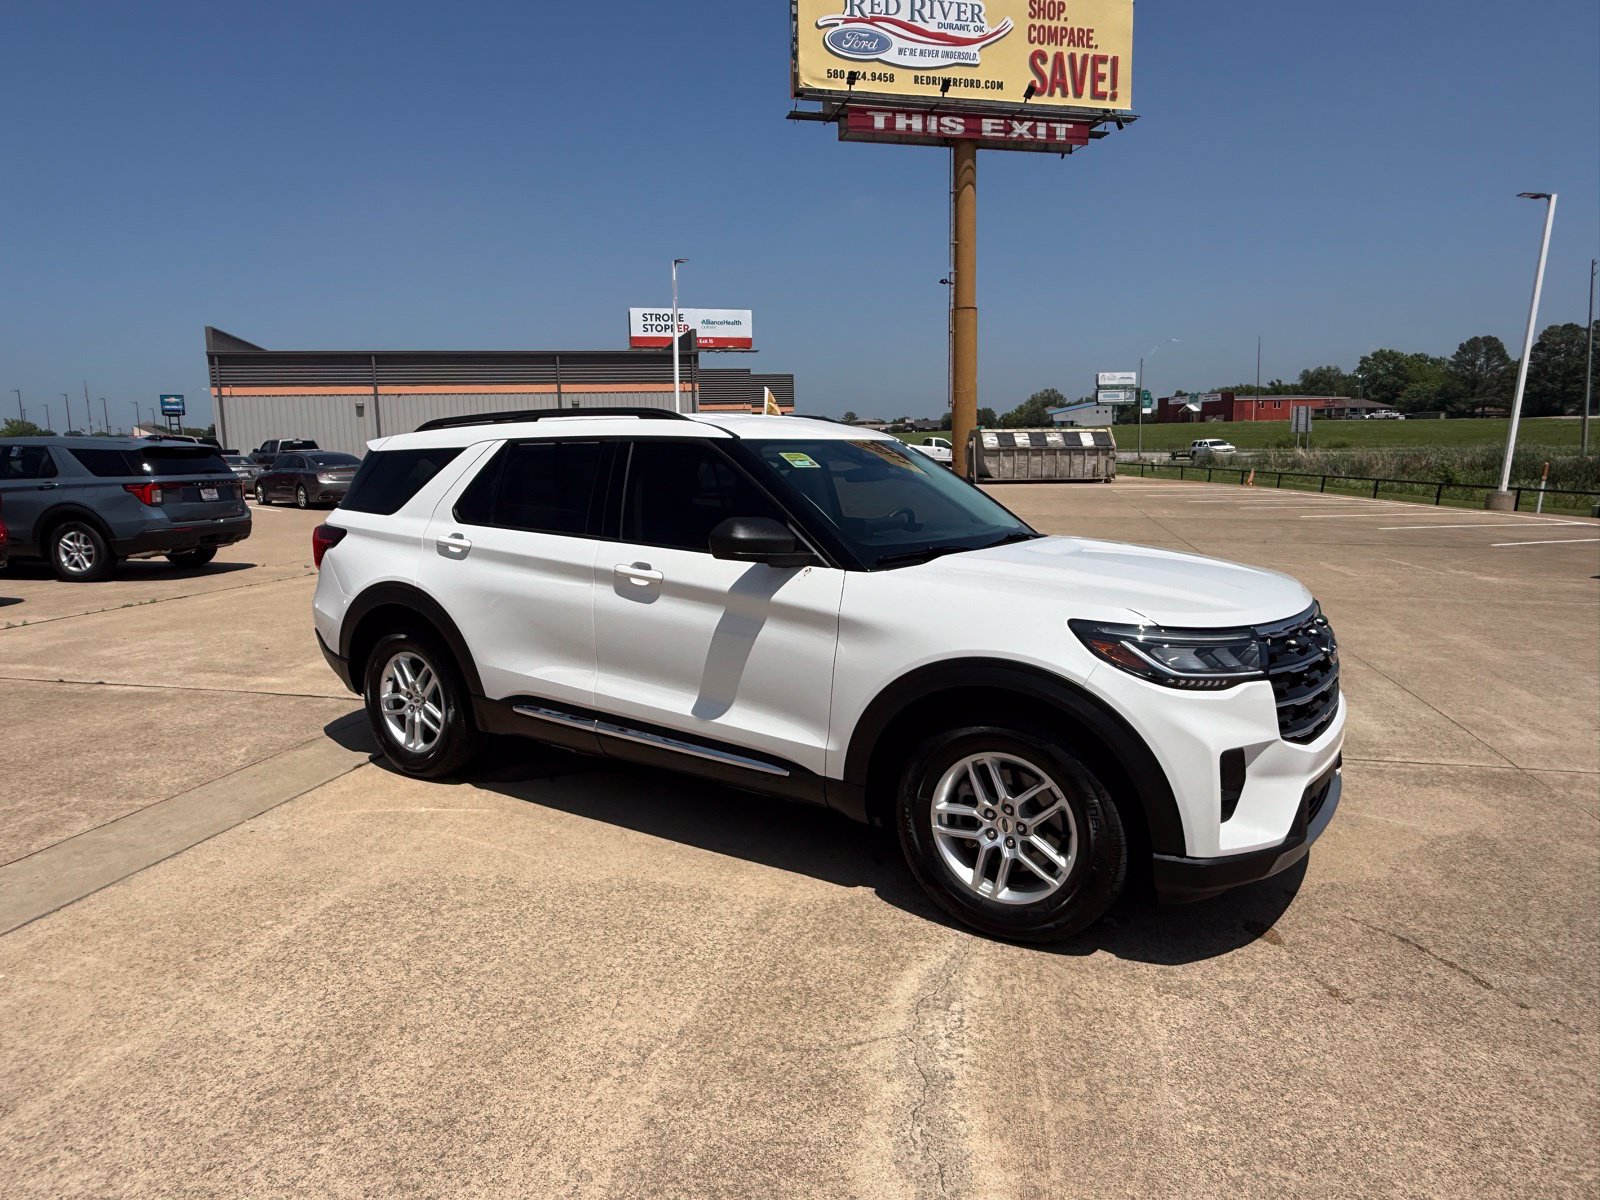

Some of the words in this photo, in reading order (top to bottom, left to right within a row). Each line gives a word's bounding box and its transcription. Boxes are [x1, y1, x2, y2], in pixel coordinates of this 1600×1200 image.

[846, 0, 900, 18] RED
[908, 0, 985, 24] RIVER
[1028, 0, 1068, 22] SHOP.
[937, 21, 971, 33] DURANT,
[974, 24, 985, 33] OK
[1027, 23, 1099, 50] COMPARE.
[842, 31, 879, 50] Ford
[897, 46, 917, 57] WE'RE
[919, 48, 940, 59] NEVER
[941, 50, 978, 62] UNDERSOLD.
[826, 68, 895, 83] 580.24.9458
[1029, 49, 1119, 101] SAVE!
[866, 111, 965, 135] THIS
[981, 117, 1074, 141] EXIT
